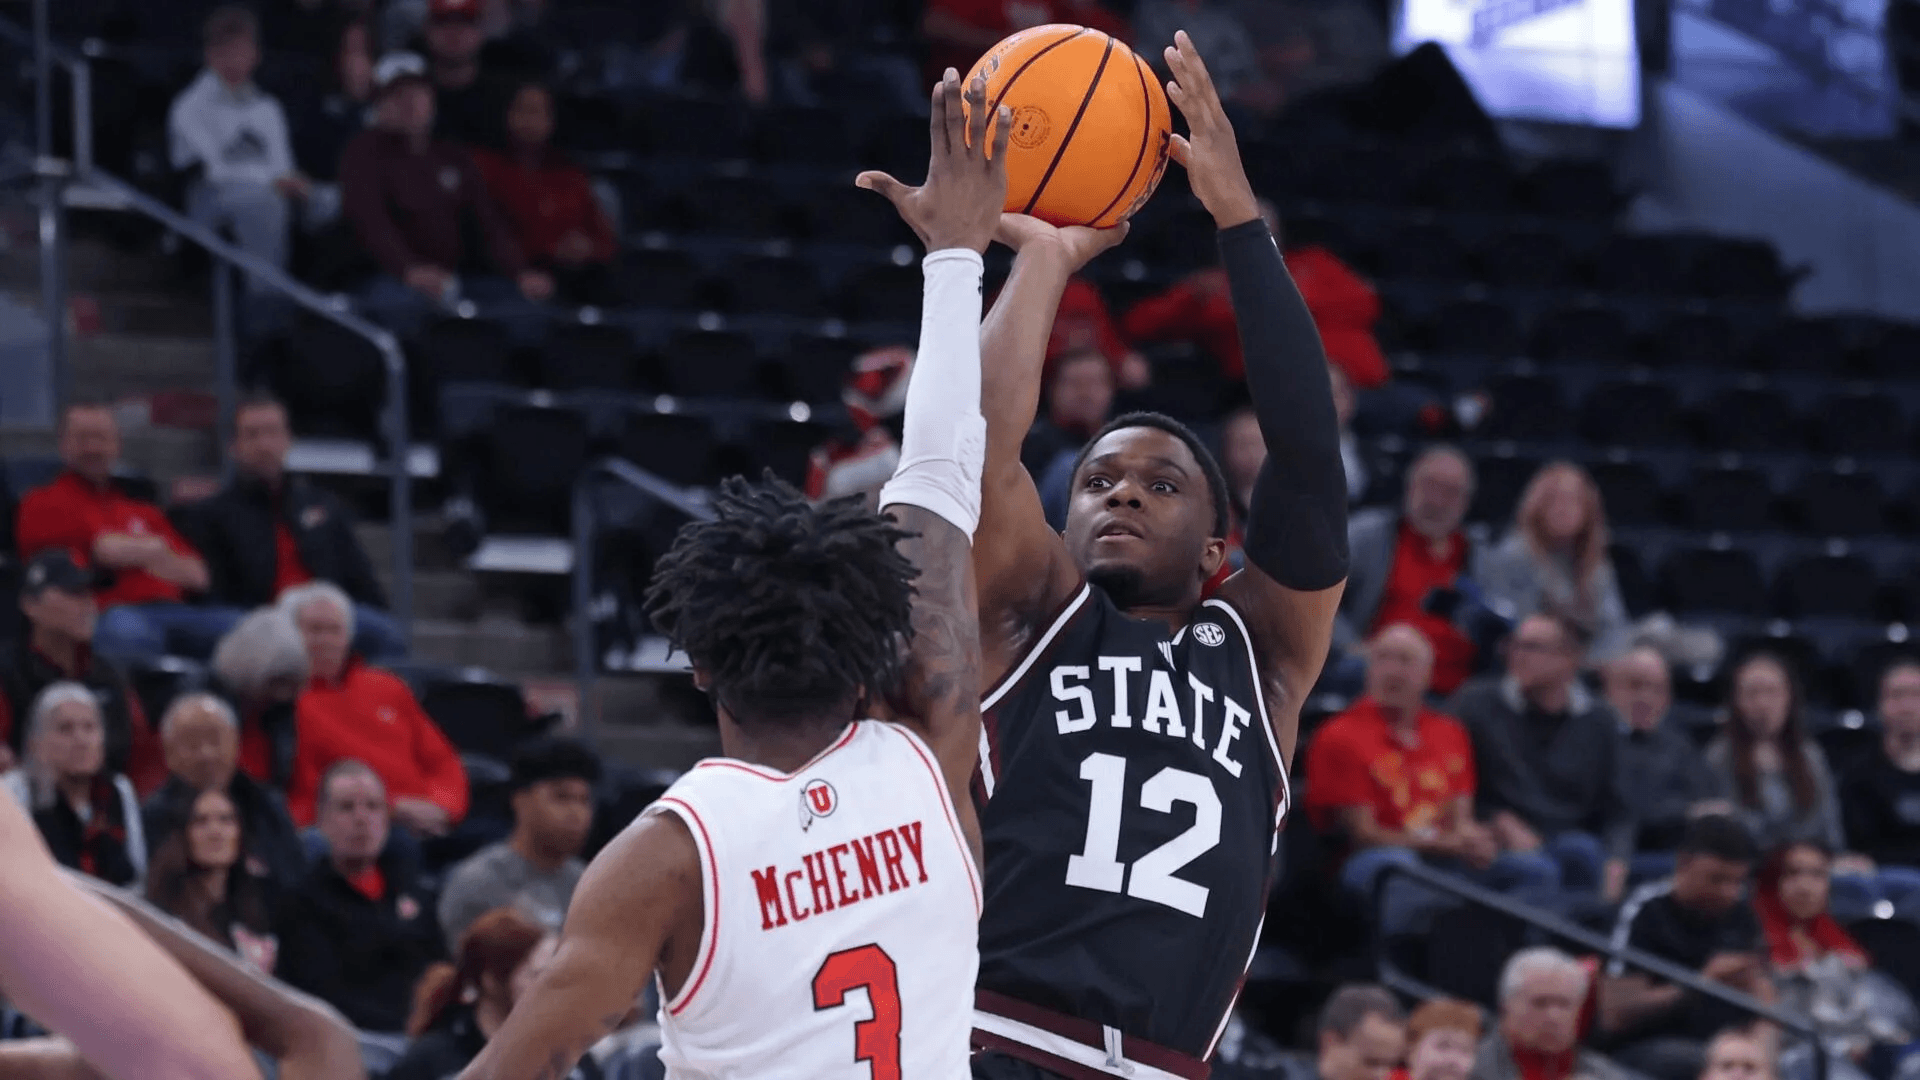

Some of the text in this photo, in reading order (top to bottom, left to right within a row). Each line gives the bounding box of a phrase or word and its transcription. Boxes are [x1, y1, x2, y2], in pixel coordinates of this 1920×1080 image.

[1195, 624, 1223, 645] SEC
[1050, 656, 1251, 779] STATE
[808, 784, 831, 813] U
[1065, 752, 1223, 918] 12
[751, 820, 929, 931] McHENRY
[811, 942, 903, 1080] 3
